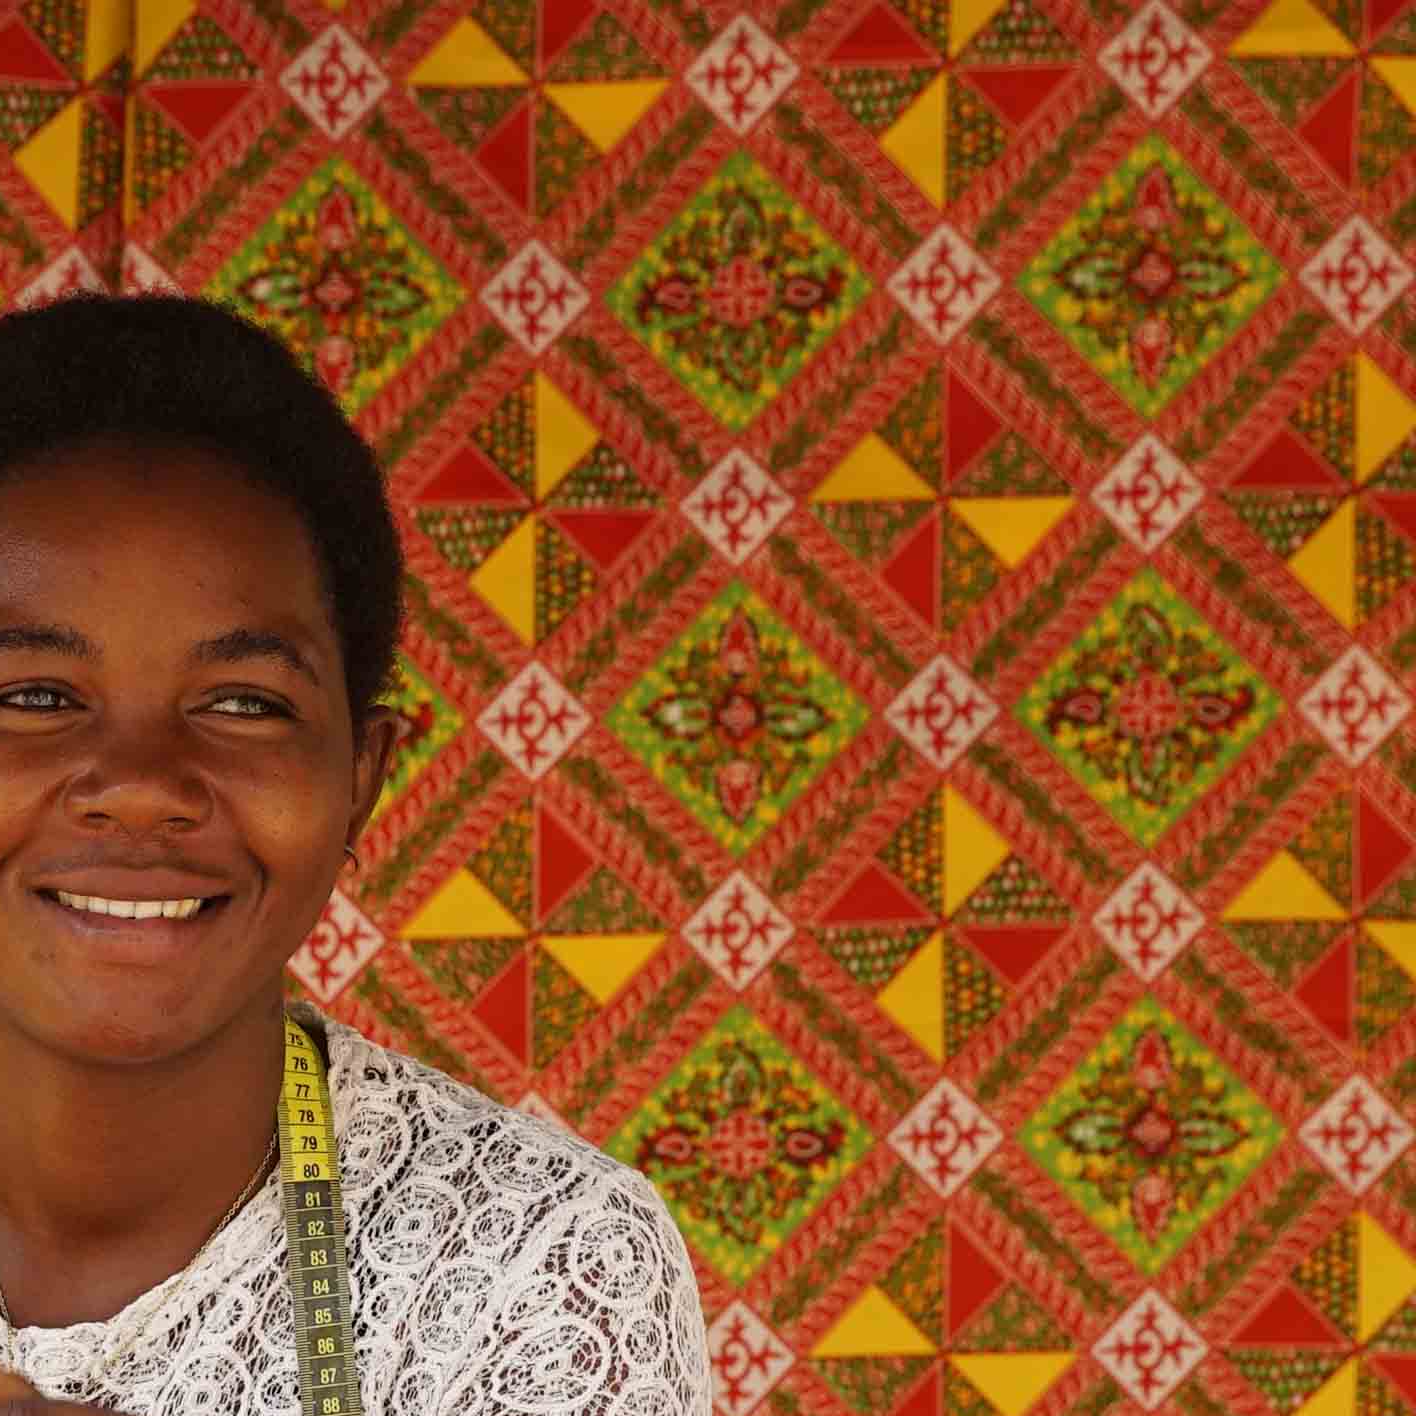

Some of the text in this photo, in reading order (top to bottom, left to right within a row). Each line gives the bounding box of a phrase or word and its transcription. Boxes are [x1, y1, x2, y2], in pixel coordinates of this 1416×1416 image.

[292, 1057, 309, 1071] 76
[295, 1083, 311, 1098] 77
[298, 1110, 315, 1123] 78
[301, 1136, 318, 1150] 79
[303, 1163, 320, 1178] 80
[305, 1192, 321, 1207] 81
[307, 1221, 325, 1237] 82
[310, 1250, 328, 1266] 83
[312, 1279, 330, 1295] 84
[314, 1308, 332, 1324] 85
[317, 1337, 335, 1354] 86
[320, 1368, 337, 1384] 87
[323, 1398, 341, 1414] 88
